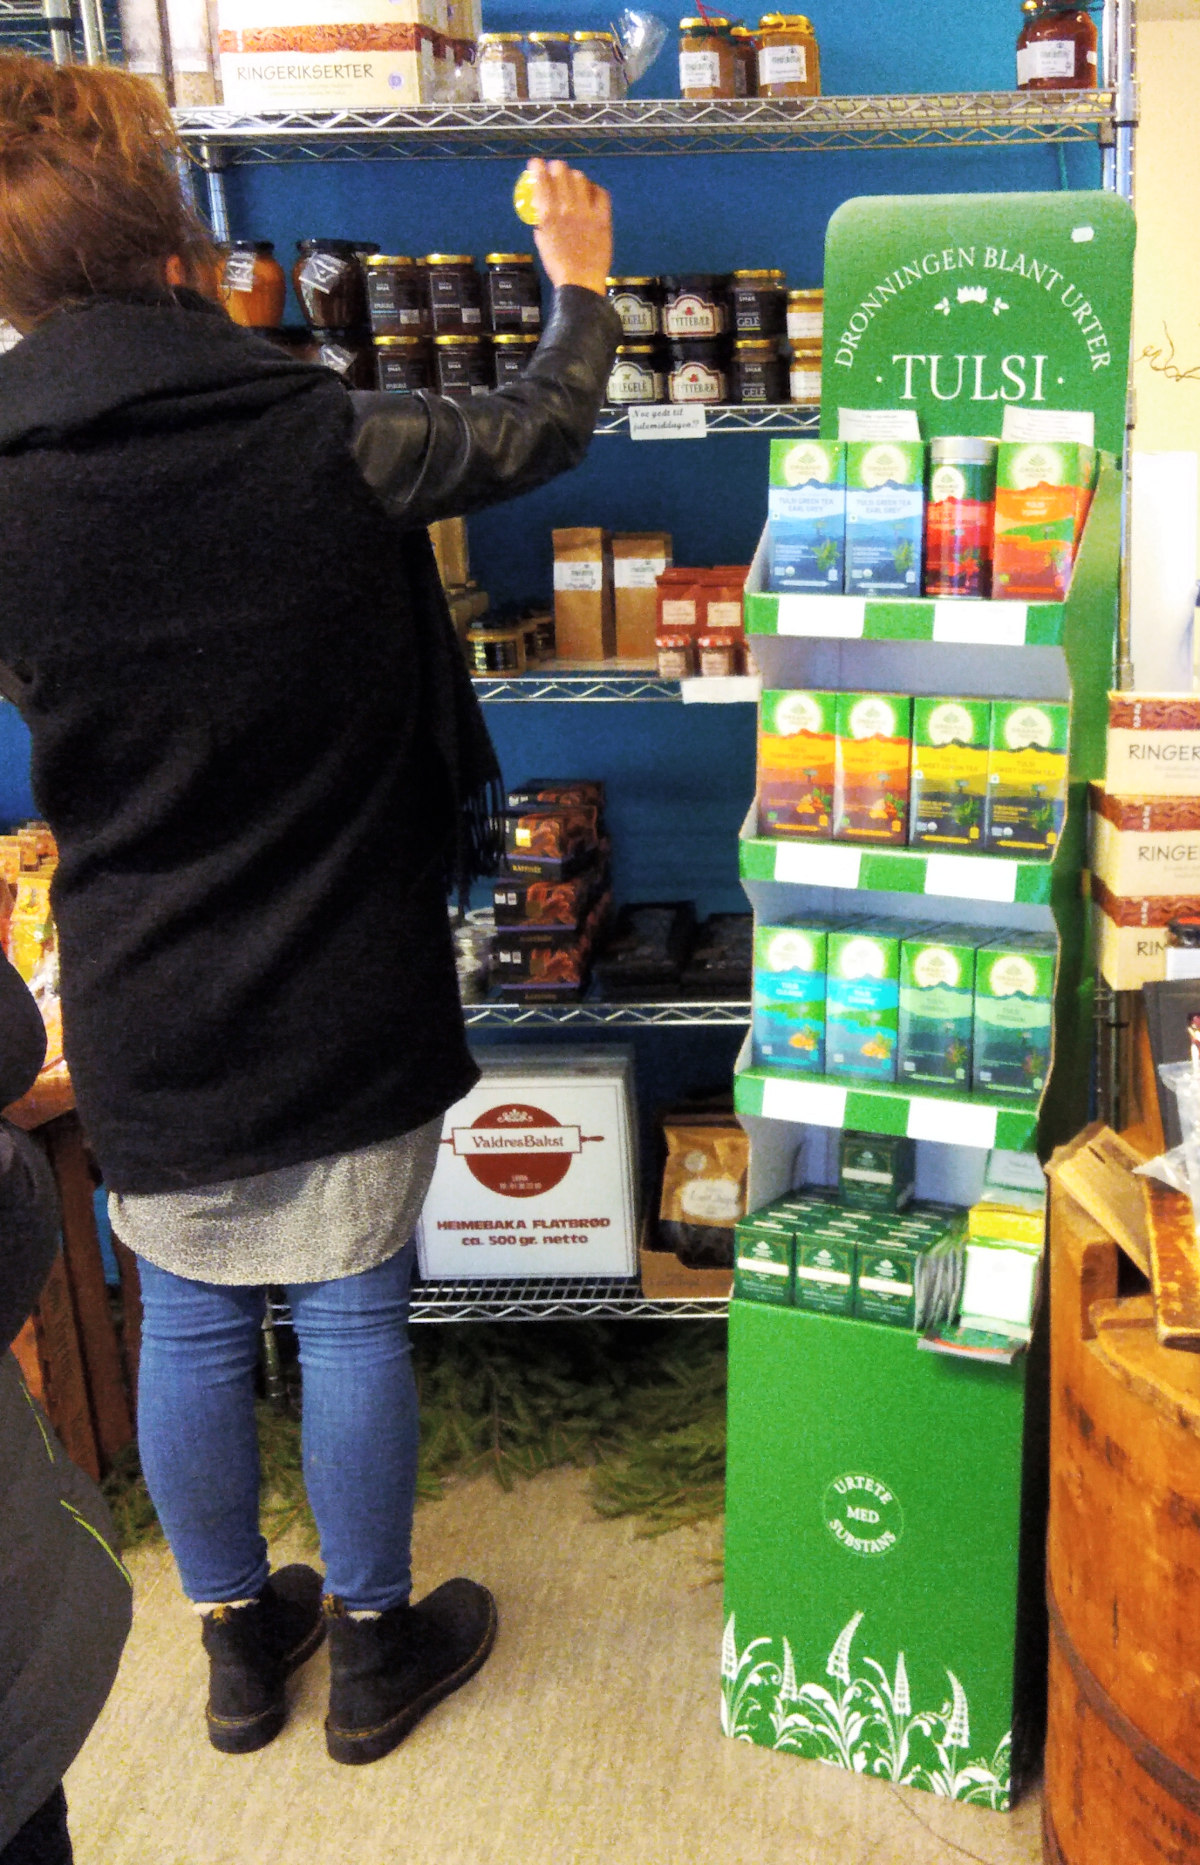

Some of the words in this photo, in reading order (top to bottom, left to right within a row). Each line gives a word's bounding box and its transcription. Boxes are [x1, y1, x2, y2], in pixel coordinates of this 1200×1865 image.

[237, 63, 375, 81] RINGERIKSERTER
[834, 246, 975, 368] DRONNINGEN
[984, 247, 1063, 291] BLANT
[1061, 284, 1112, 371] URTER
[892, 355, 1048, 401] TULSI
[1129, 743, 1200, 761] RINGER
[1138, 844, 1199, 861] RINGE
[471, 1134, 564, 1149] ValdresBakst
[437, 1219, 527, 1230] HEIMEBAKA
[533, 1218, 610, 1229] FLATBRØD
[462, 1236, 484, 1246] ca.
[489, 1235, 517, 1245] 500
[519, 1236, 538, 1247] gr.
[543, 1235, 589, 1245] netto
[846, 1505, 880, 1523] MED
